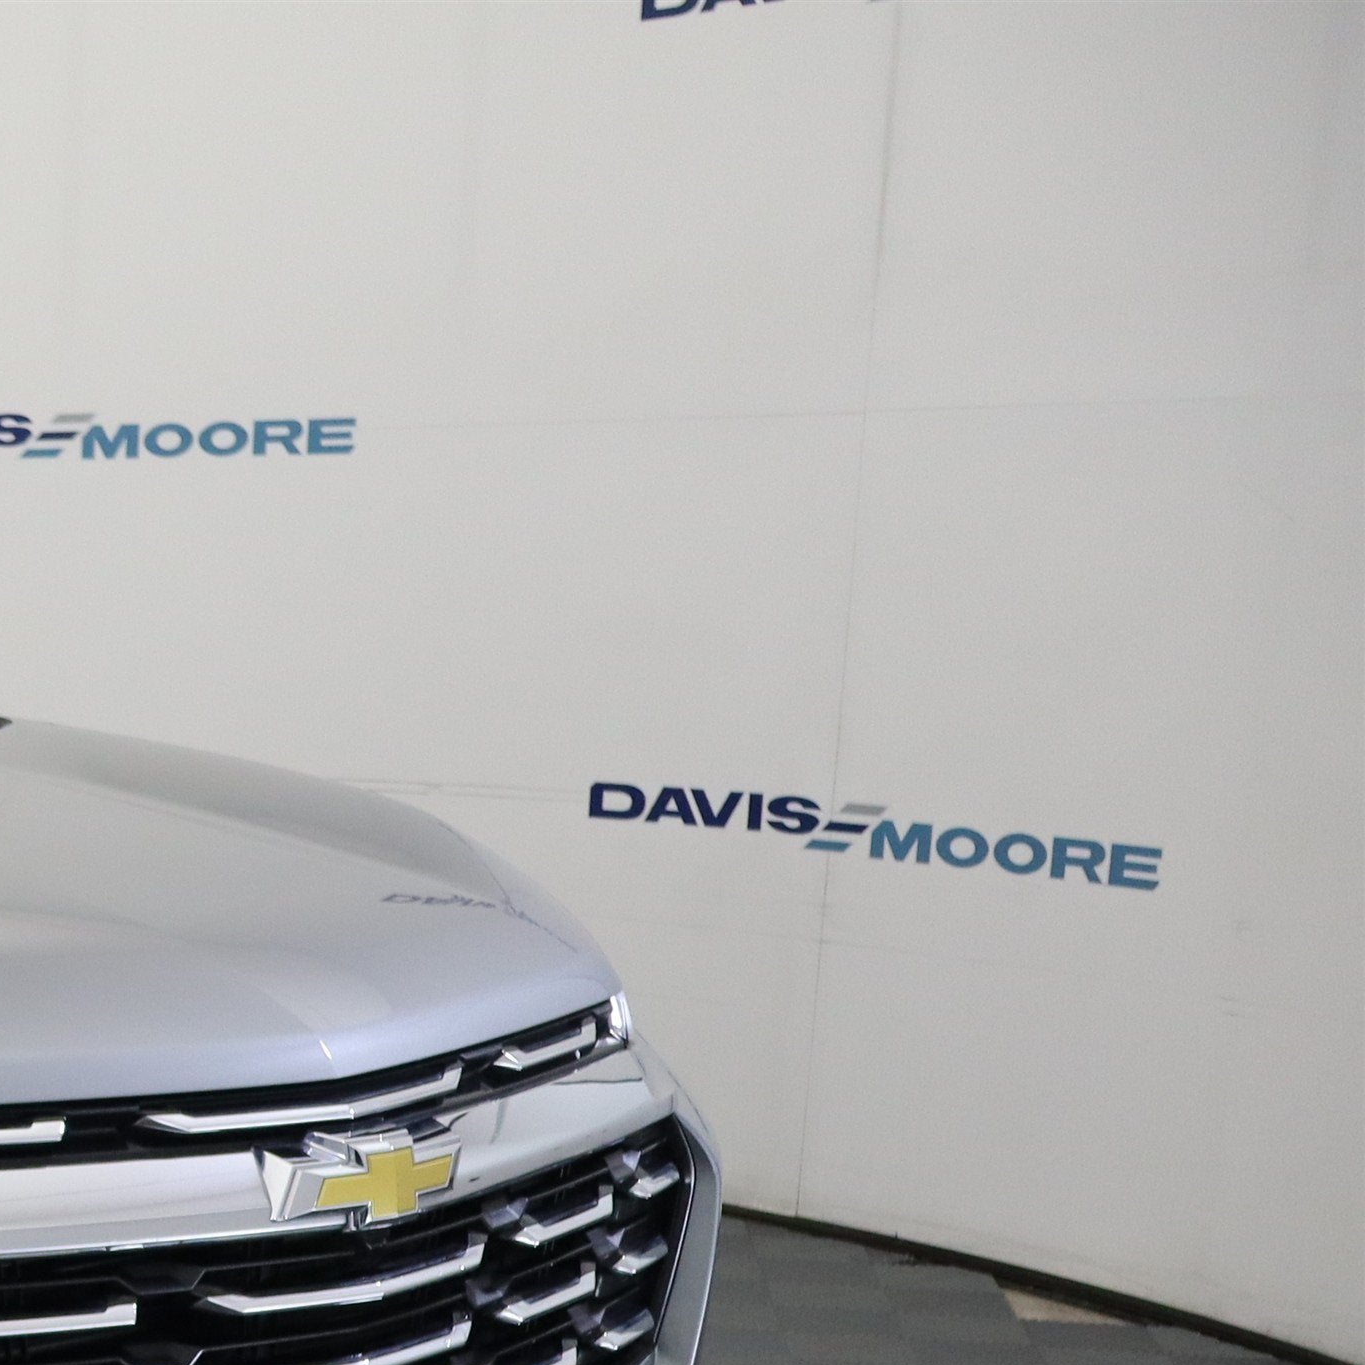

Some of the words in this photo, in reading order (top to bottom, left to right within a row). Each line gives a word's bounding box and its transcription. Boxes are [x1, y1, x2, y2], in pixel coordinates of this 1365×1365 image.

[80, 416, 357, 461] MOORE
[588, 781, 821, 836] DAVIS
[869, 819, 1163, 892] MOORE
